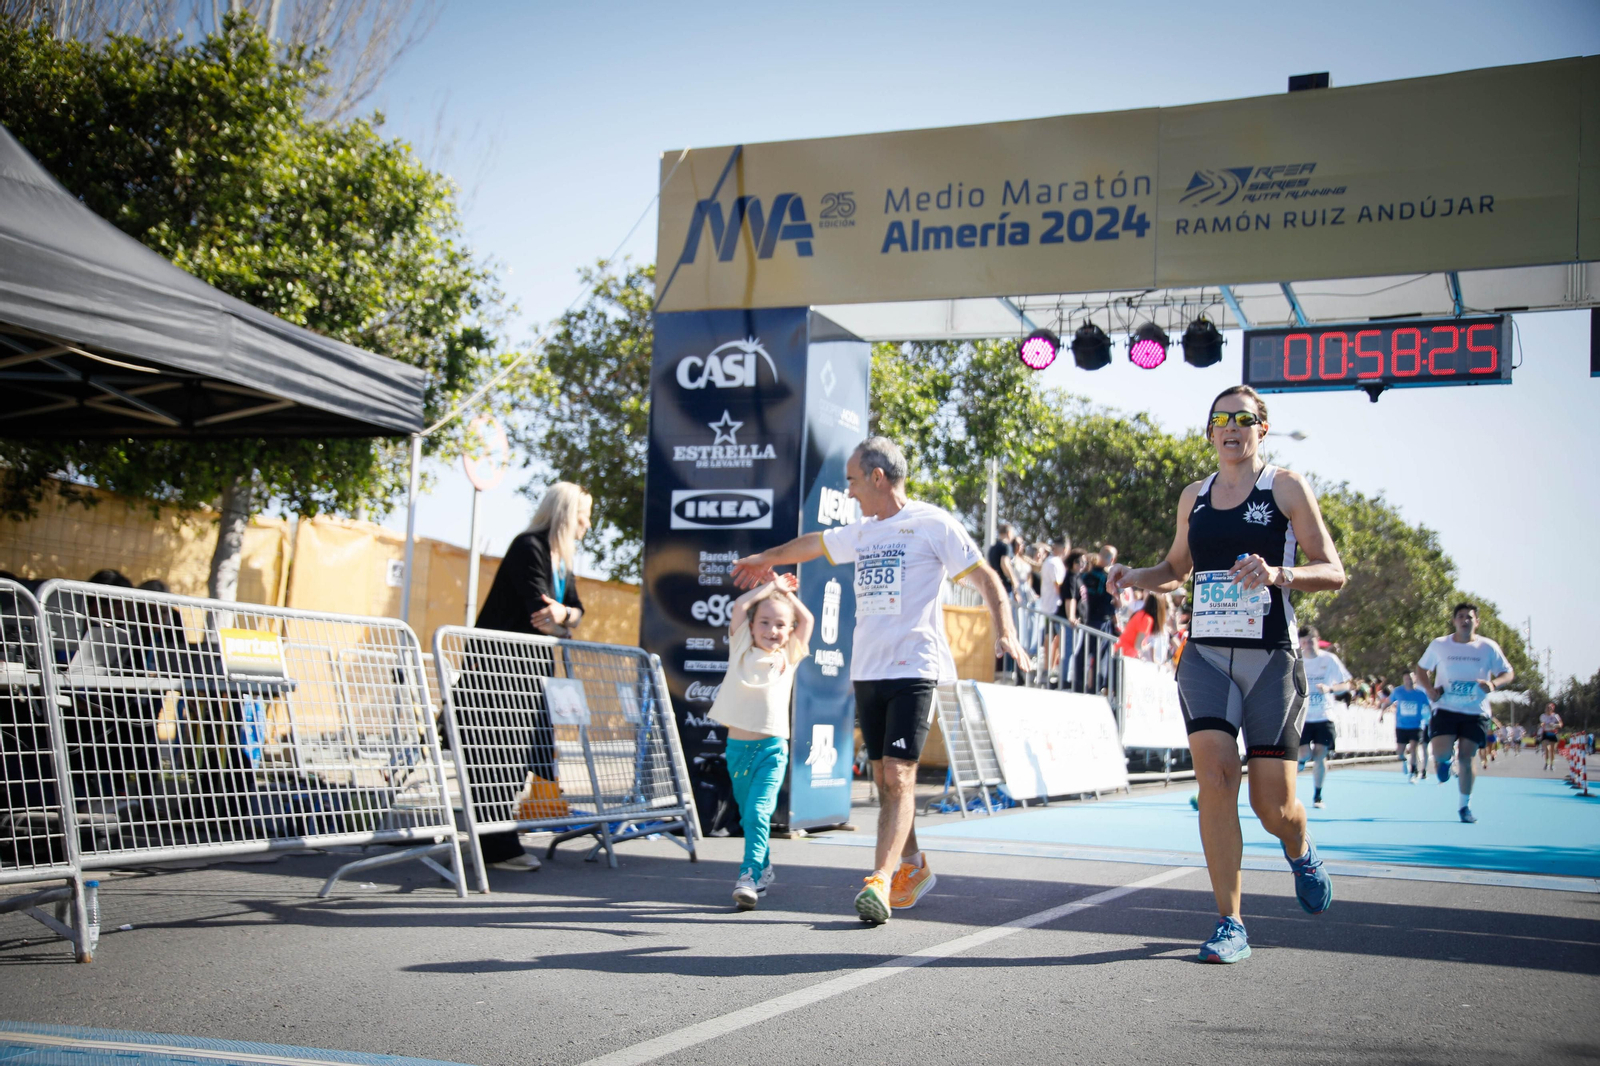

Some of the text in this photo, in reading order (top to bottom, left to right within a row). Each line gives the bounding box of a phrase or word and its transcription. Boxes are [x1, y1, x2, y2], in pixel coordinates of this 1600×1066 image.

[883, 170, 1151, 214] Medio Maratón
[1247, 177, 1311, 192] SERIES
[1284, 186, 1348, 203] RUNNING
[819, 191, 857, 219] 25
[818, 217, 857, 229] EDICIÓN
[1175, 195, 1495, 236] RAMÓN RUIZ ANDÚJAR
[880, 204, 1151, 254] Almería 2024
[675, 353, 757, 390] CASI
[672, 443, 778, 461] ESTRELLA
[710, 459, 754, 469] LEVANTE
[684, 500, 762, 518] IKEA
[699, 550, 739, 562] Barceló
[881, 548, 906, 558] 2024
[698, 562, 726, 574] Cabo
[698, 574, 723, 586] Gata
[857, 567, 895, 587] 5558
[1200, 582, 1243, 603] 564
[685, 637, 715, 650] SER
